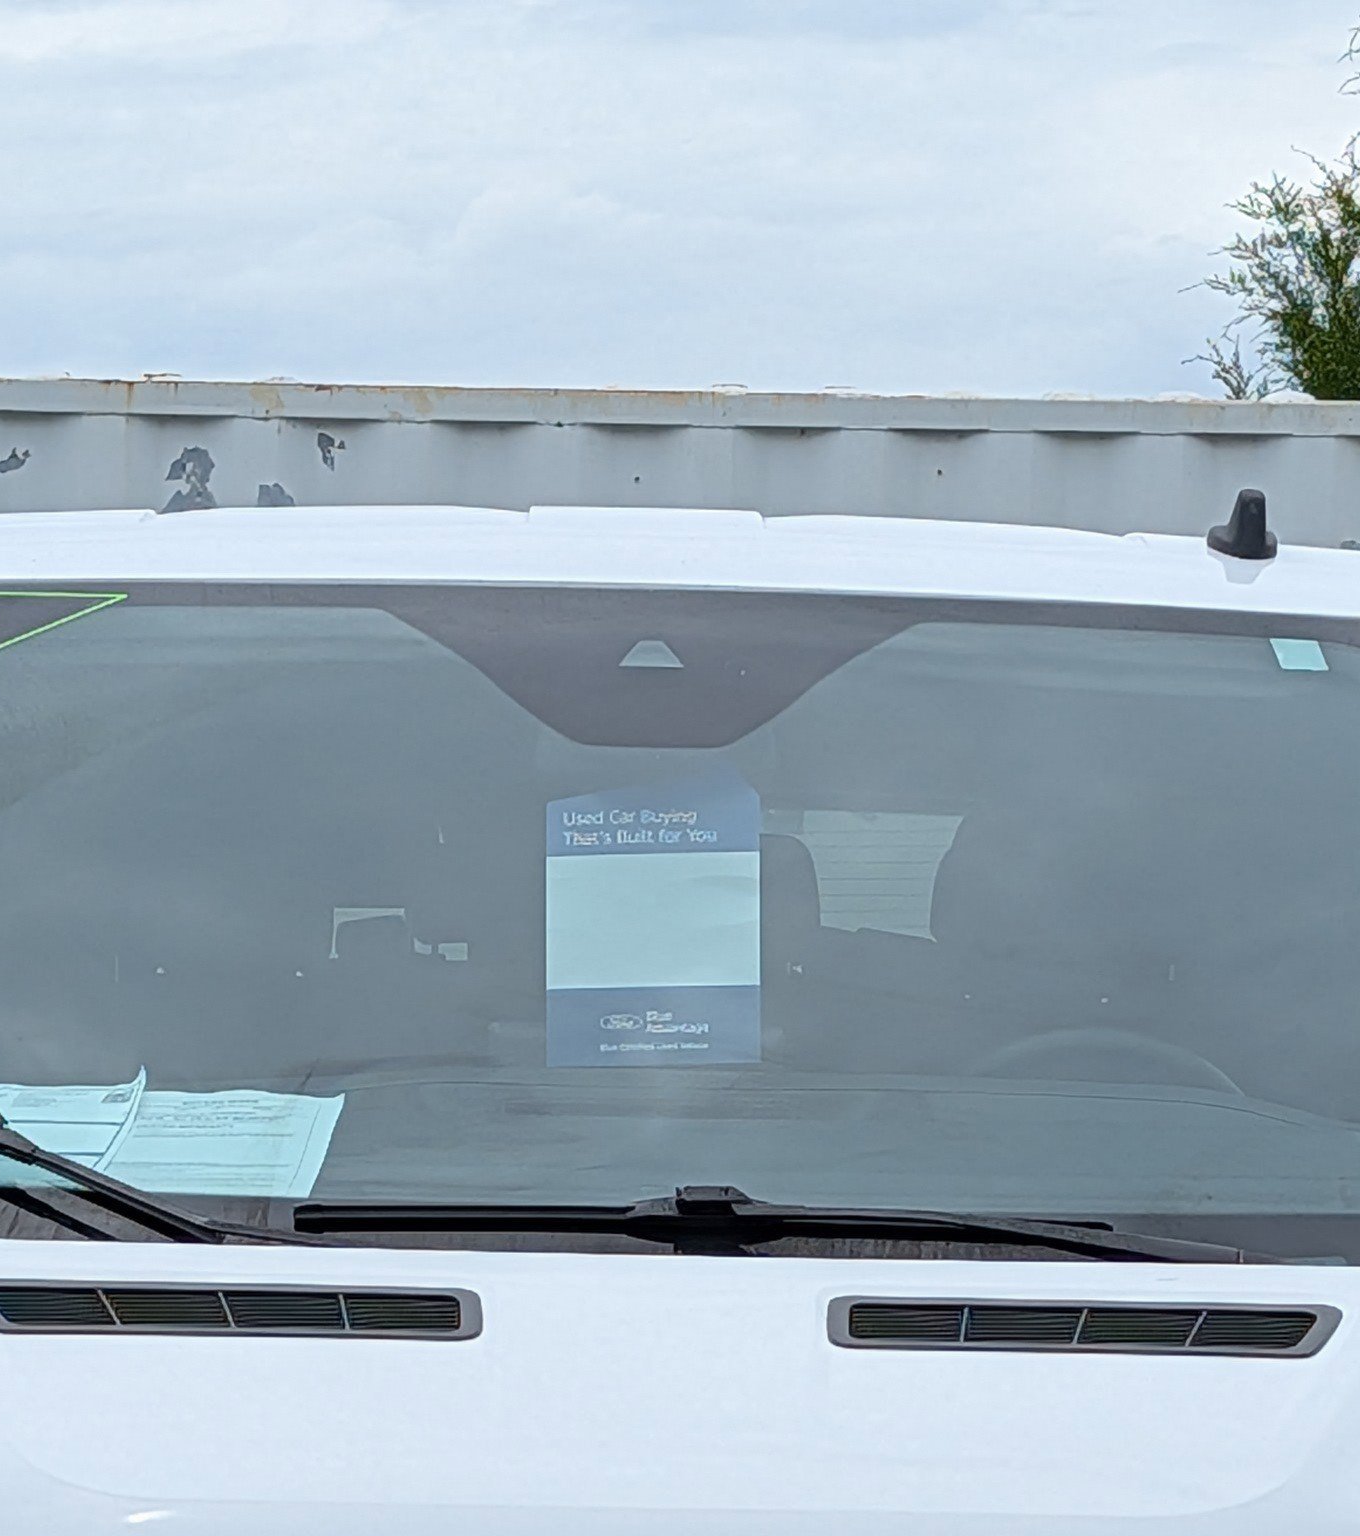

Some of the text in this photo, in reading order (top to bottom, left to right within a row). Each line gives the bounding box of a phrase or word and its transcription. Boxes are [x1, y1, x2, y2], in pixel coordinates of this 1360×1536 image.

[562, 809, 698, 827] Used Car Buying
[658, 828, 683, 844] for
[686, 828, 718, 843] You
